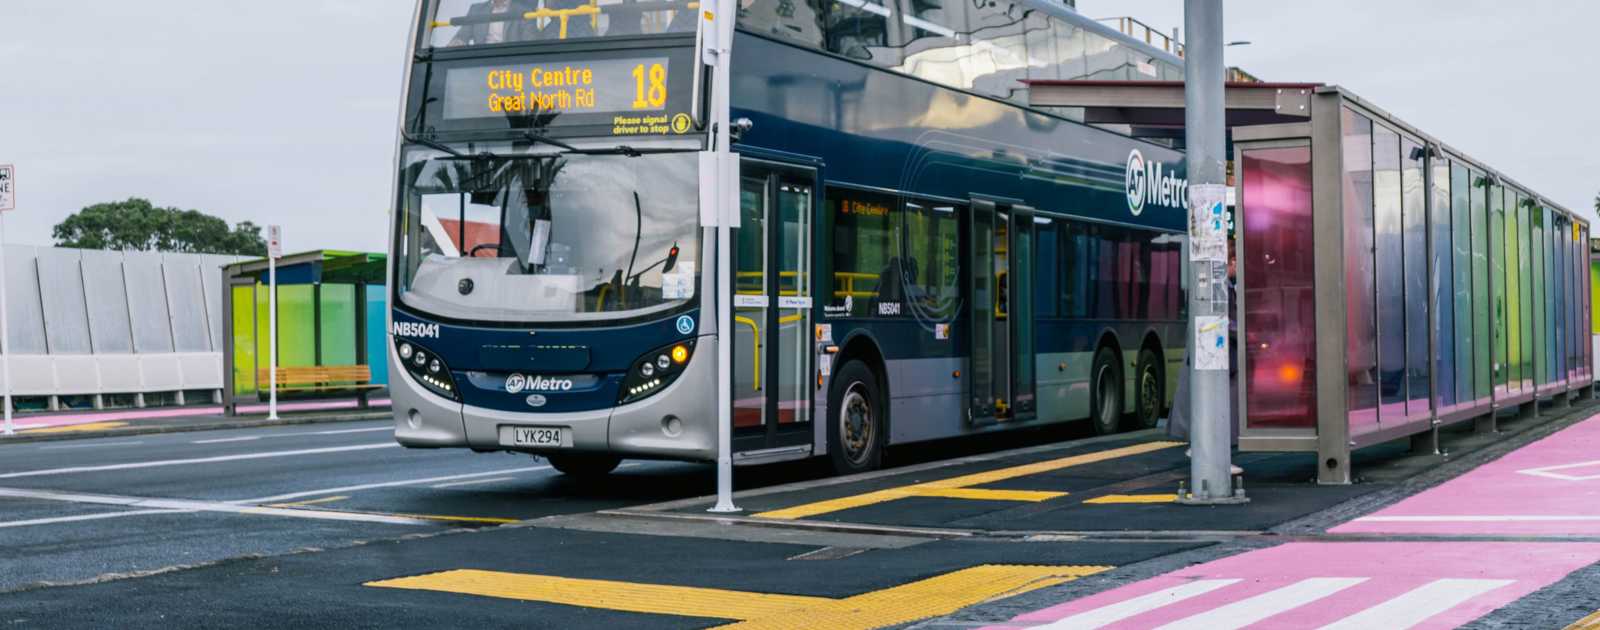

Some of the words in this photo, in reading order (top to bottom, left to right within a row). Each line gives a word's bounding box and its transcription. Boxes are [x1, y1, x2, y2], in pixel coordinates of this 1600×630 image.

[488, 69, 523, 91] City
[531, 66, 592, 87] Centre
[631, 63, 667, 109] 18
[489, 91, 526, 112] Great
[530, 89, 571, 111] North
[576, 88, 594, 108] Rd
[614, 115, 641, 125] Please
[643, 113, 667, 126] signal
[613, 126, 639, 135] driver
[650, 125, 669, 135] stop
[393, 321, 440, 338] NB5041
[525, 376, 572, 390] Metro
[516, 430, 560, 443] LYK294
